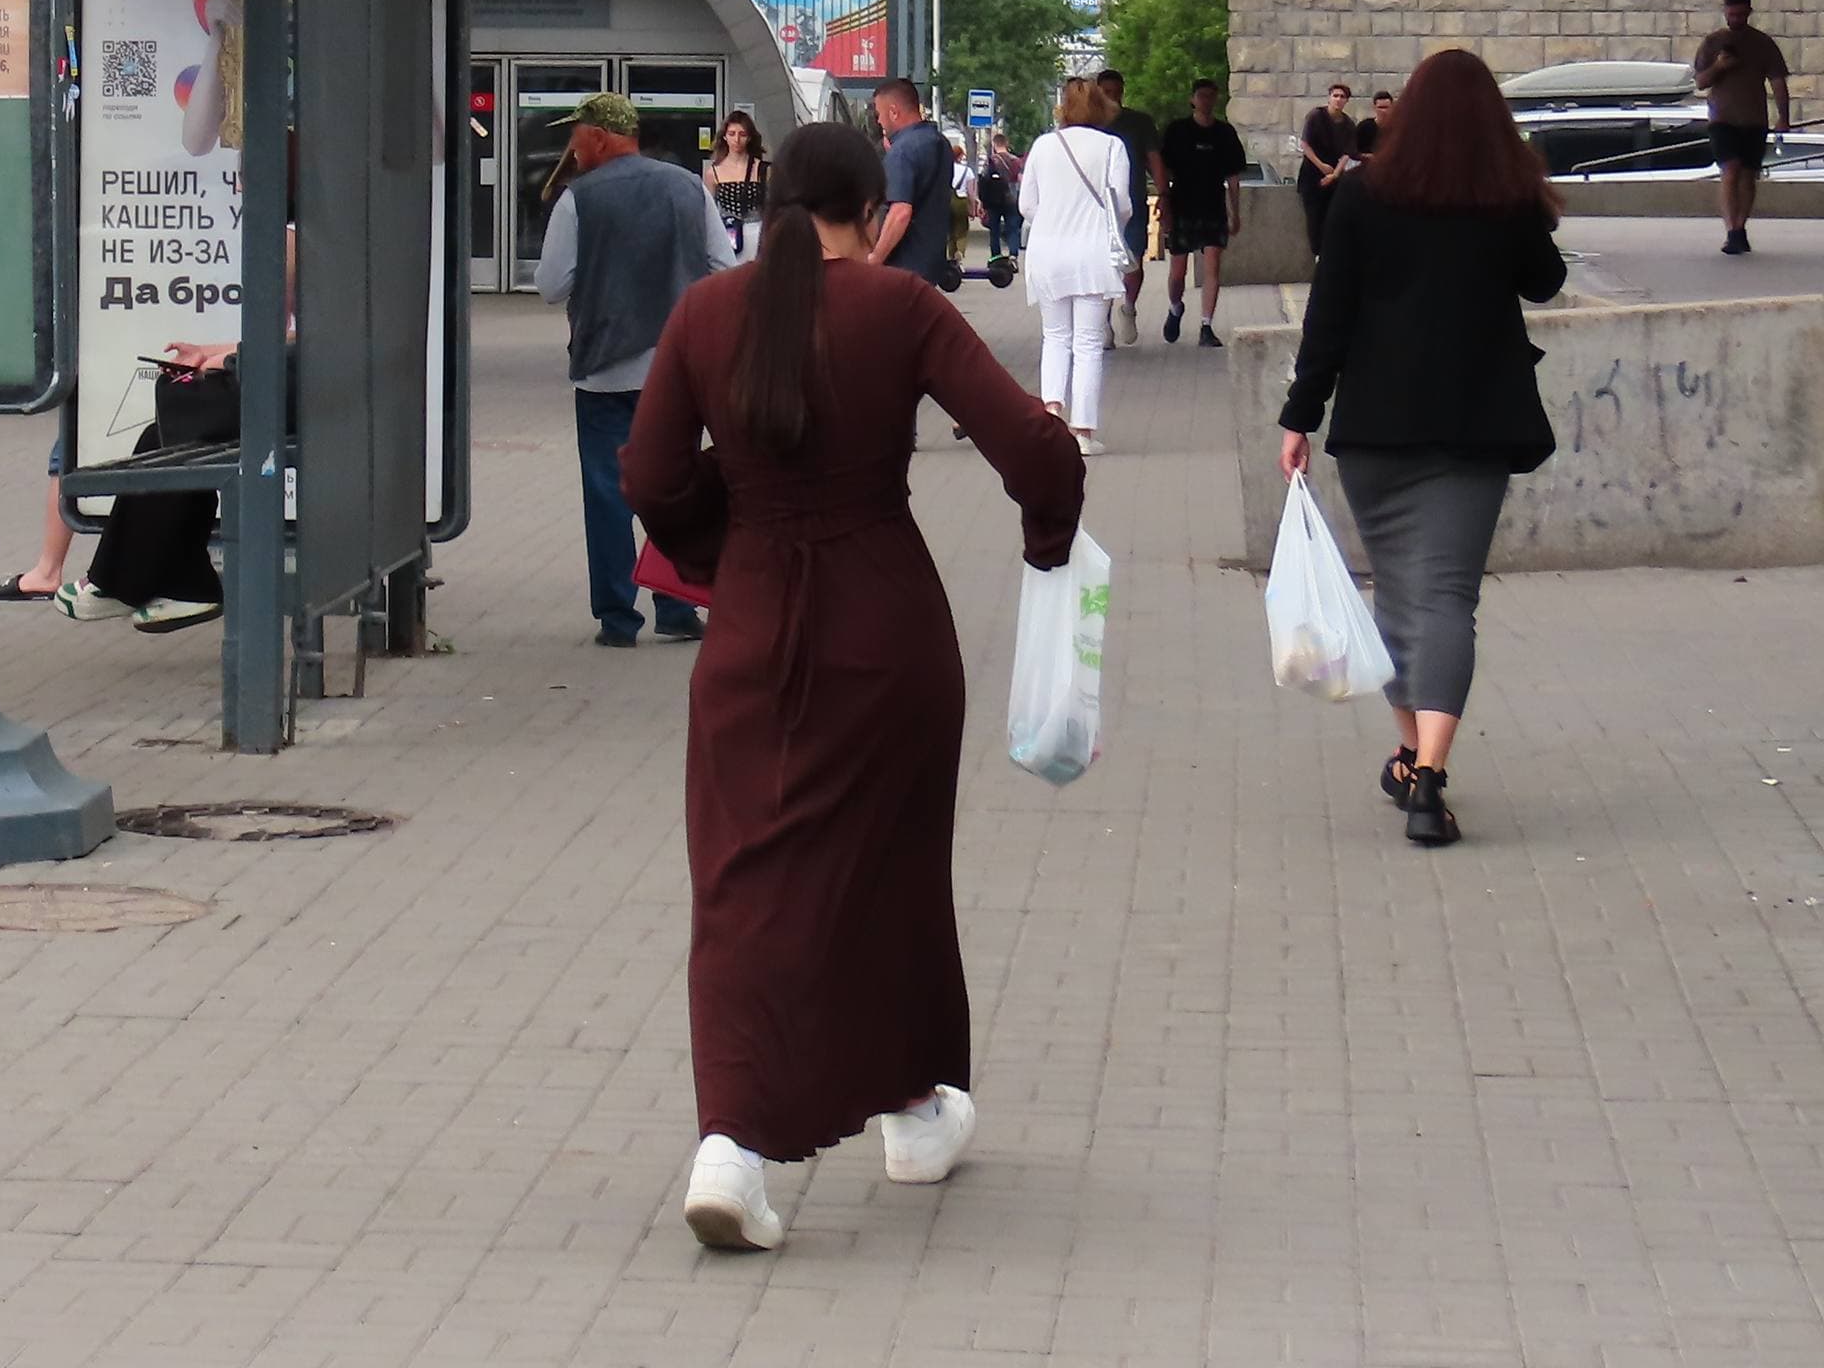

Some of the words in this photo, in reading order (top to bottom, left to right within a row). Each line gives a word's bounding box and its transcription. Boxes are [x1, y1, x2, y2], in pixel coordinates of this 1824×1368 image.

[102, 171, 206, 198] РЕШИЛ,
[102, 205, 214, 229] КАШЕЛЬ
[102, 239, 134, 263] НЕ
[150, 239, 230, 264] ИЗ-ЗА
[100, 277, 160, 310] Да
[168, 276, 243, 313] бро
